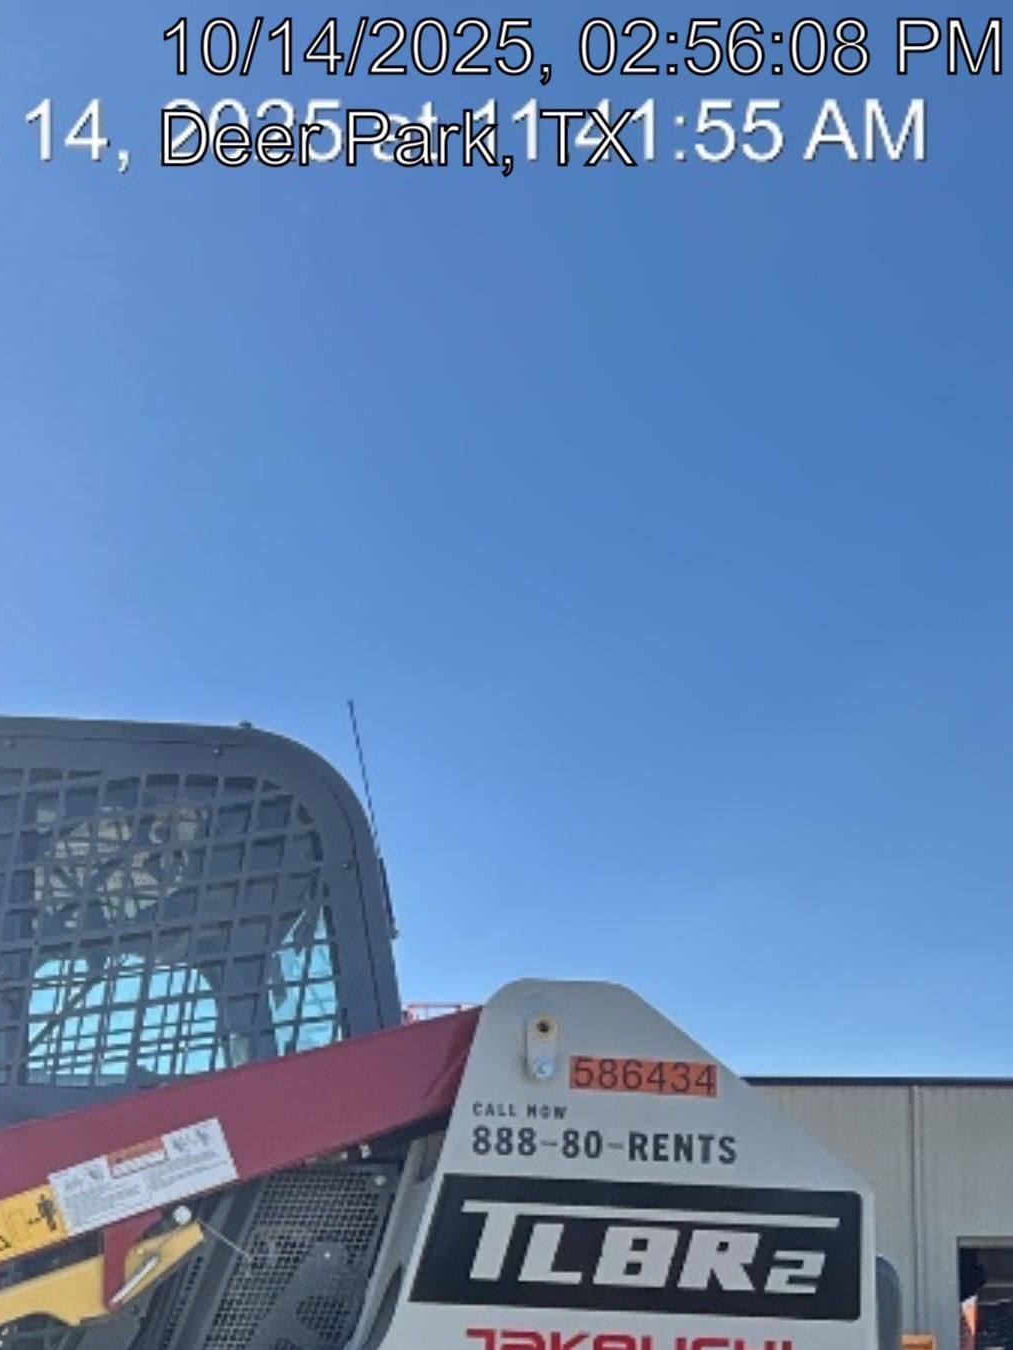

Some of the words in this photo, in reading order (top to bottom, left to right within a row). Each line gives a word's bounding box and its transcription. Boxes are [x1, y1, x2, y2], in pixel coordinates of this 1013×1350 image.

[573, 1057, 715, 1096] 586434
[472, 1102, 518, 1118] CALL
[526, 1104, 568, 1121] NOW
[472, 1125, 738, 1165] 888-80-RENTS
